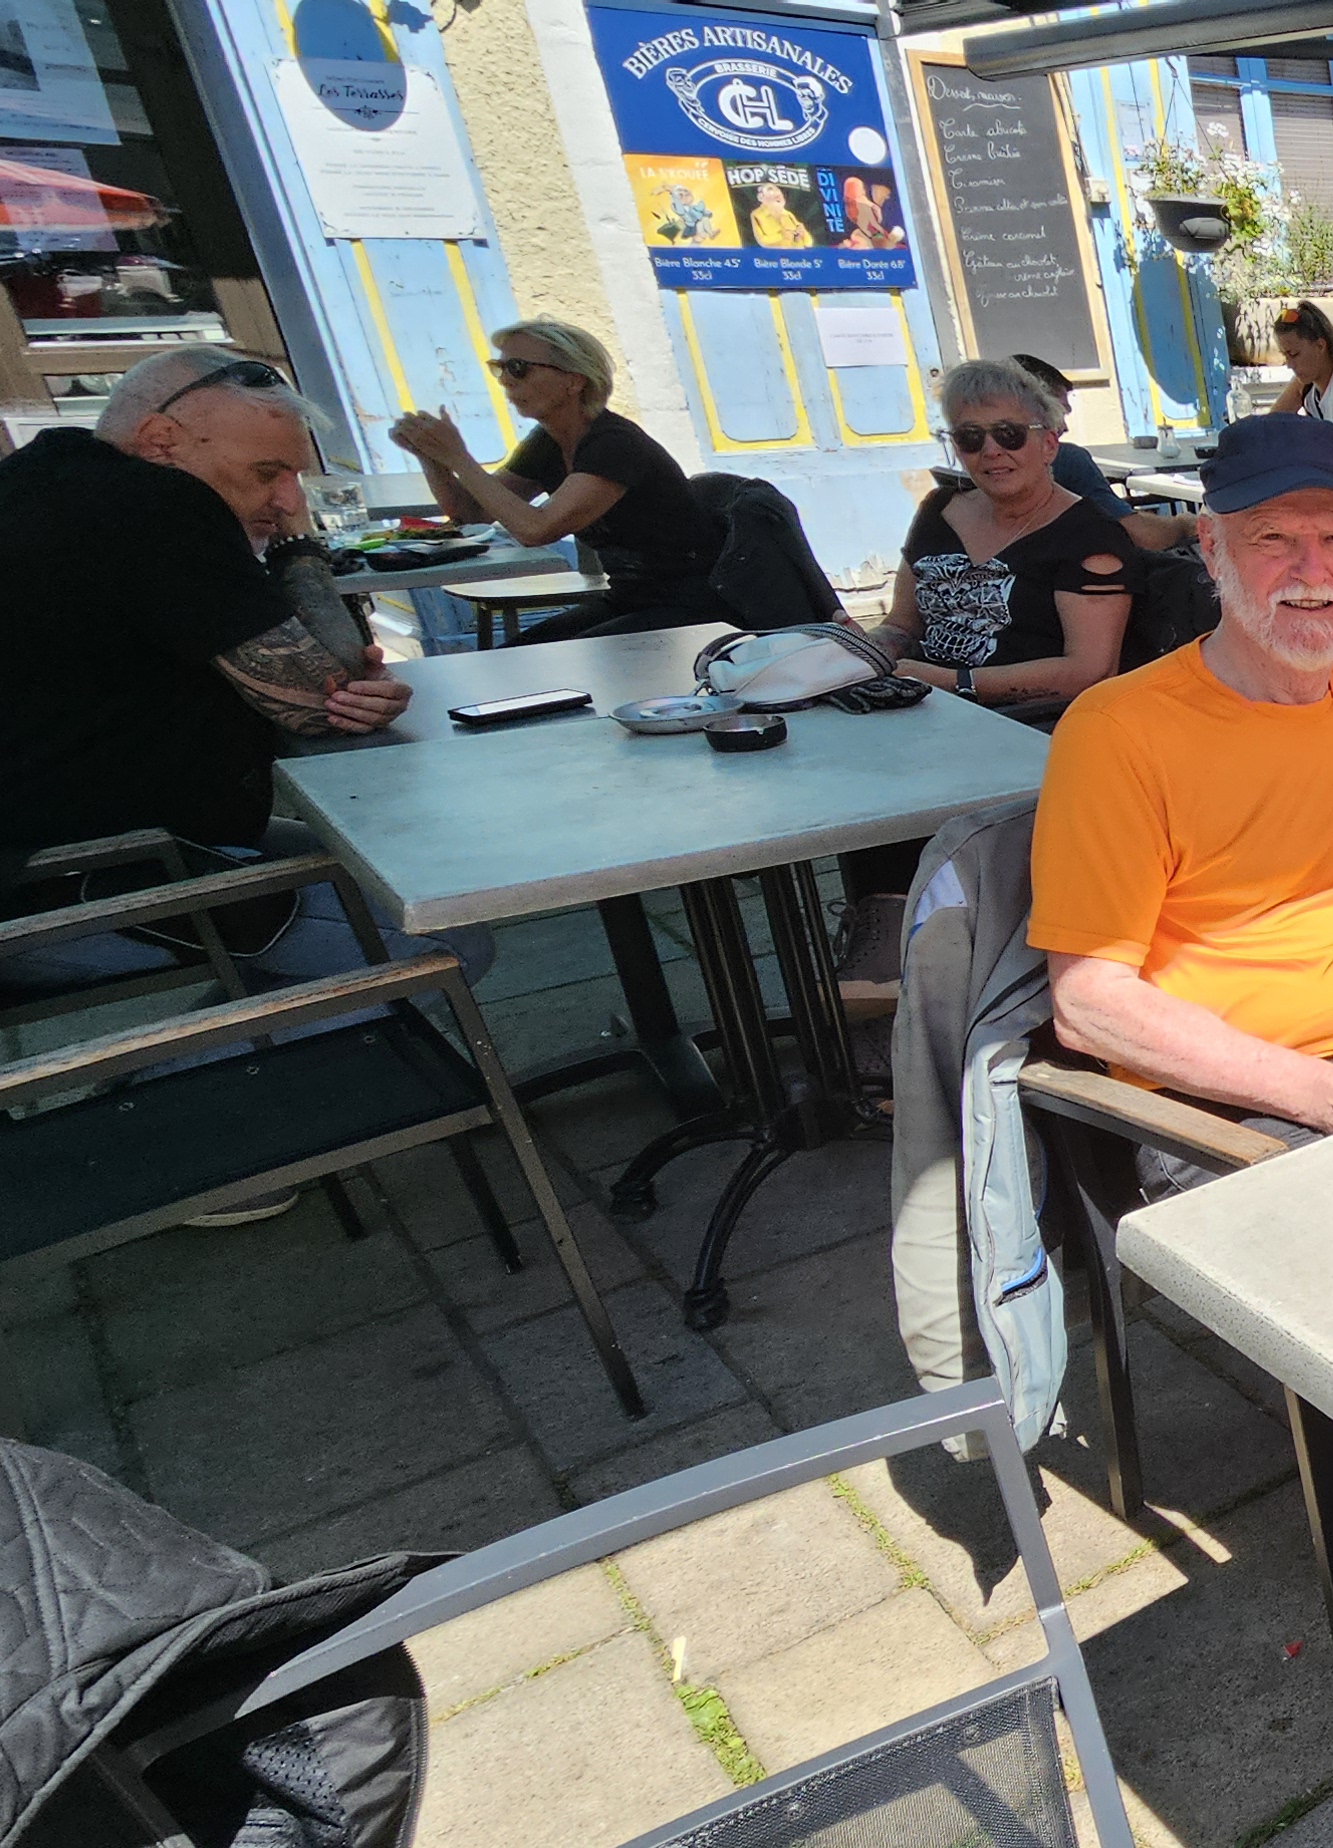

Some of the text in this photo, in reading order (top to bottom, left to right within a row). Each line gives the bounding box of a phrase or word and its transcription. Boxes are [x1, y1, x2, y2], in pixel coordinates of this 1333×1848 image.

[622, 26, 853, 94] BIÈRES ARTISANALES
[714, 62, 778, 78] BRASSERIE
[344, 85, 403, 99] Terrasses
[682, 257, 722, 268] Blanche
